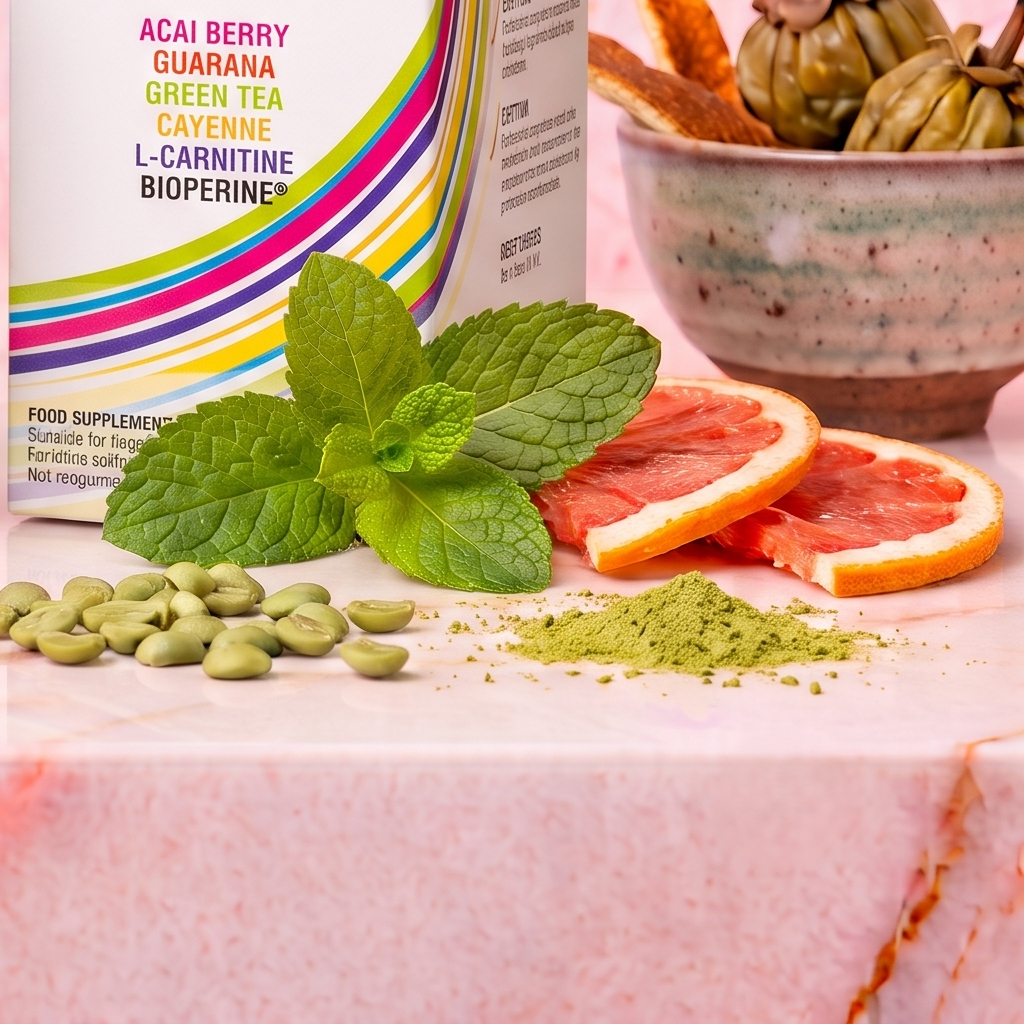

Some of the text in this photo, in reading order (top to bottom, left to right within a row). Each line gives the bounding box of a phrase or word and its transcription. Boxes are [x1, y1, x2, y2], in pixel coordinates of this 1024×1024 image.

[139, 18, 290, 48] ACAI BERRY
[153, 49, 276, 79] GUARANA
[145, 81, 284, 111] GREEN TEA
[157, 112, 272, 142] CAYENNE
[135, 143, 294, 175] L-CARNITINE
[28, 407, 67, 424] FOOD
[88, 431, 107, 448] for
[28, 467, 52, 483] Not
